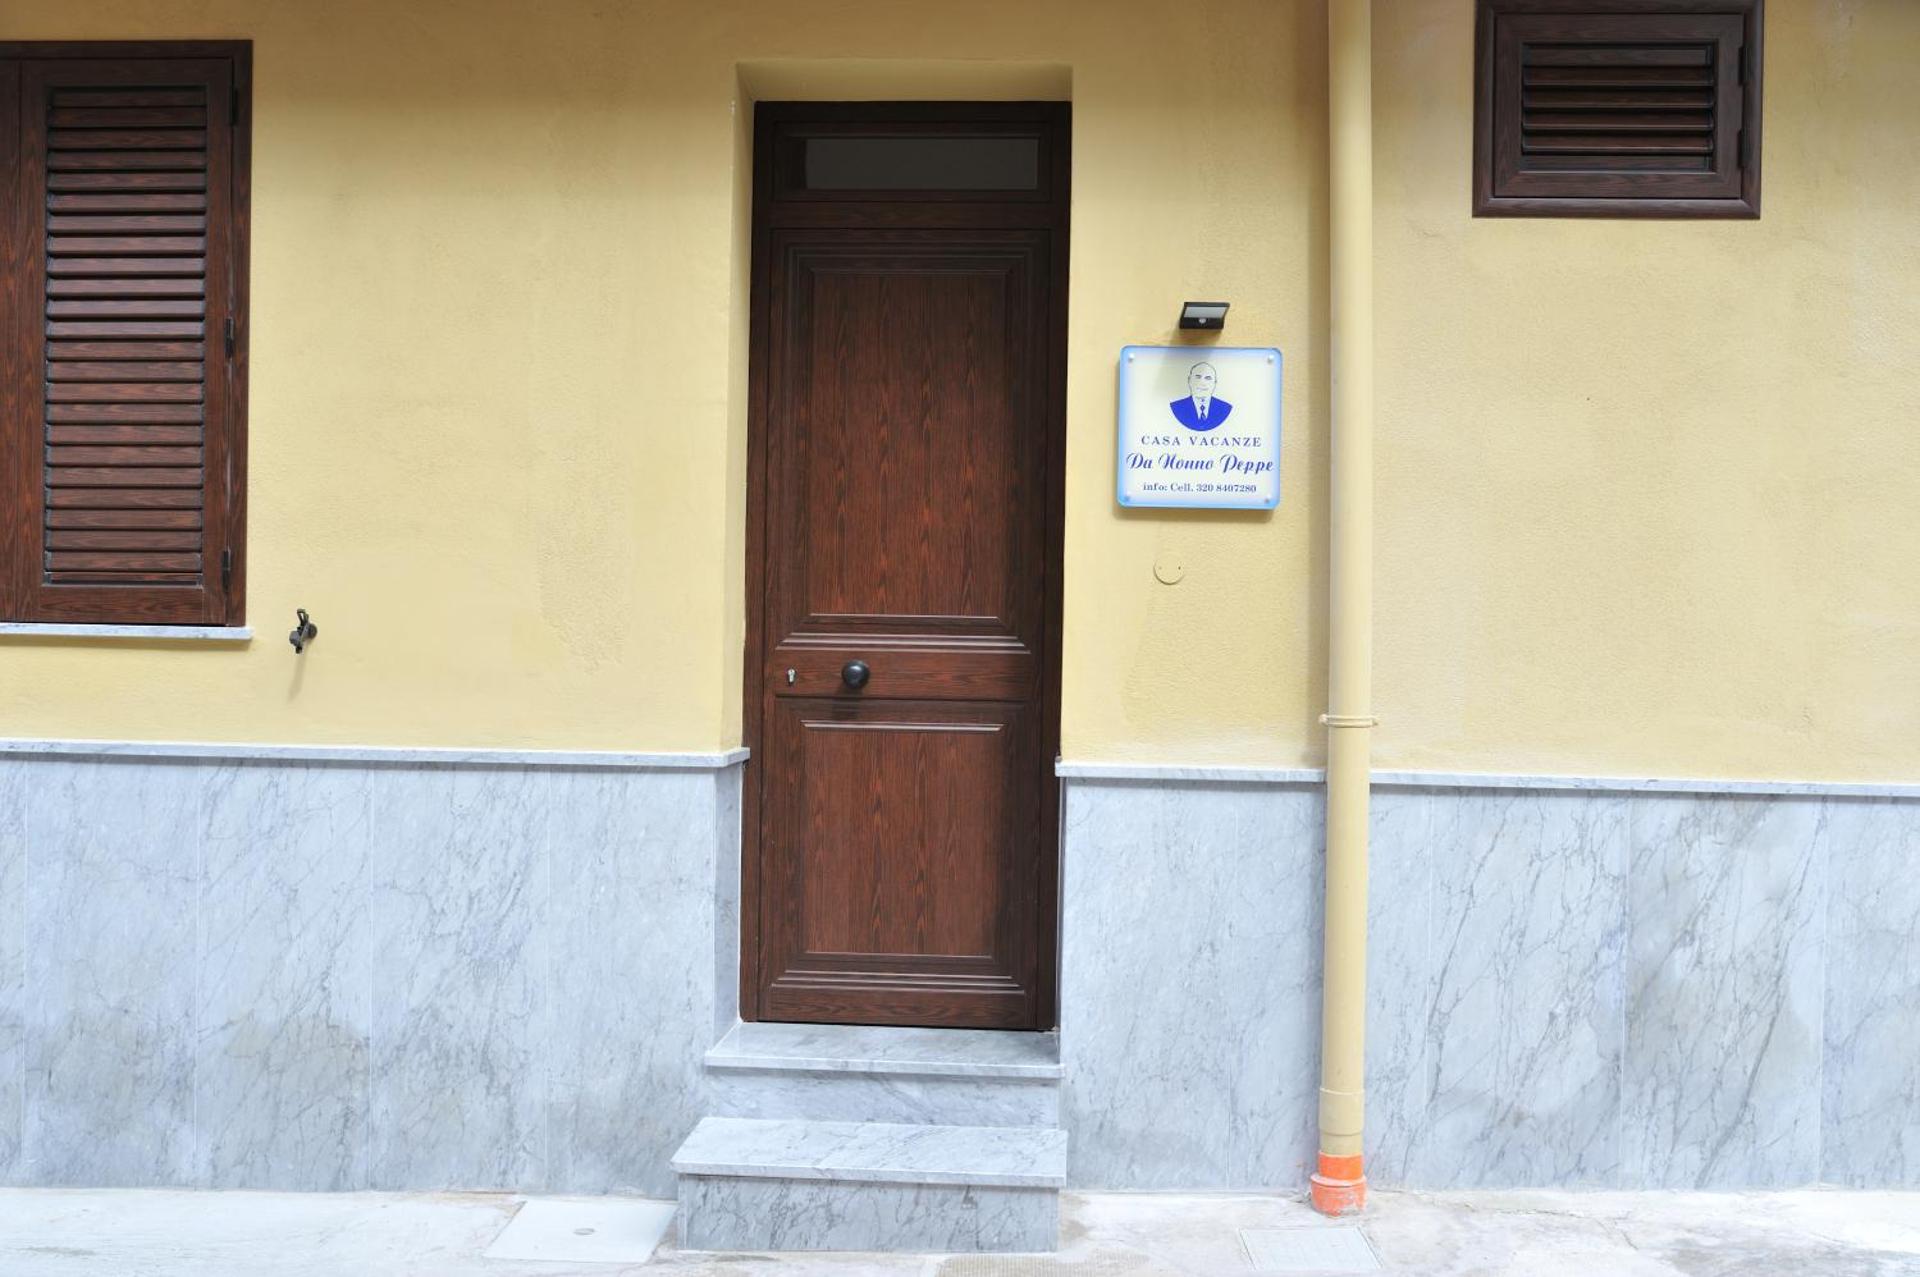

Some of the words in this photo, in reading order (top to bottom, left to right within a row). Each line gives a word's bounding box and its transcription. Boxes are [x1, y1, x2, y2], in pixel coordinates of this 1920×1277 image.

[1141, 435, 1181, 446] CASA
[1189, 436, 1262, 447] VACANZE
[1126, 452, 1153, 469] Da
[1158, 453, 1214, 470] Nonno
[1219, 453, 1274, 474] Peppe
[1143, 482, 1168, 491] info:
[1170, 483, 1194, 492] Cell.
[1196, 484, 1214, 492] 320
